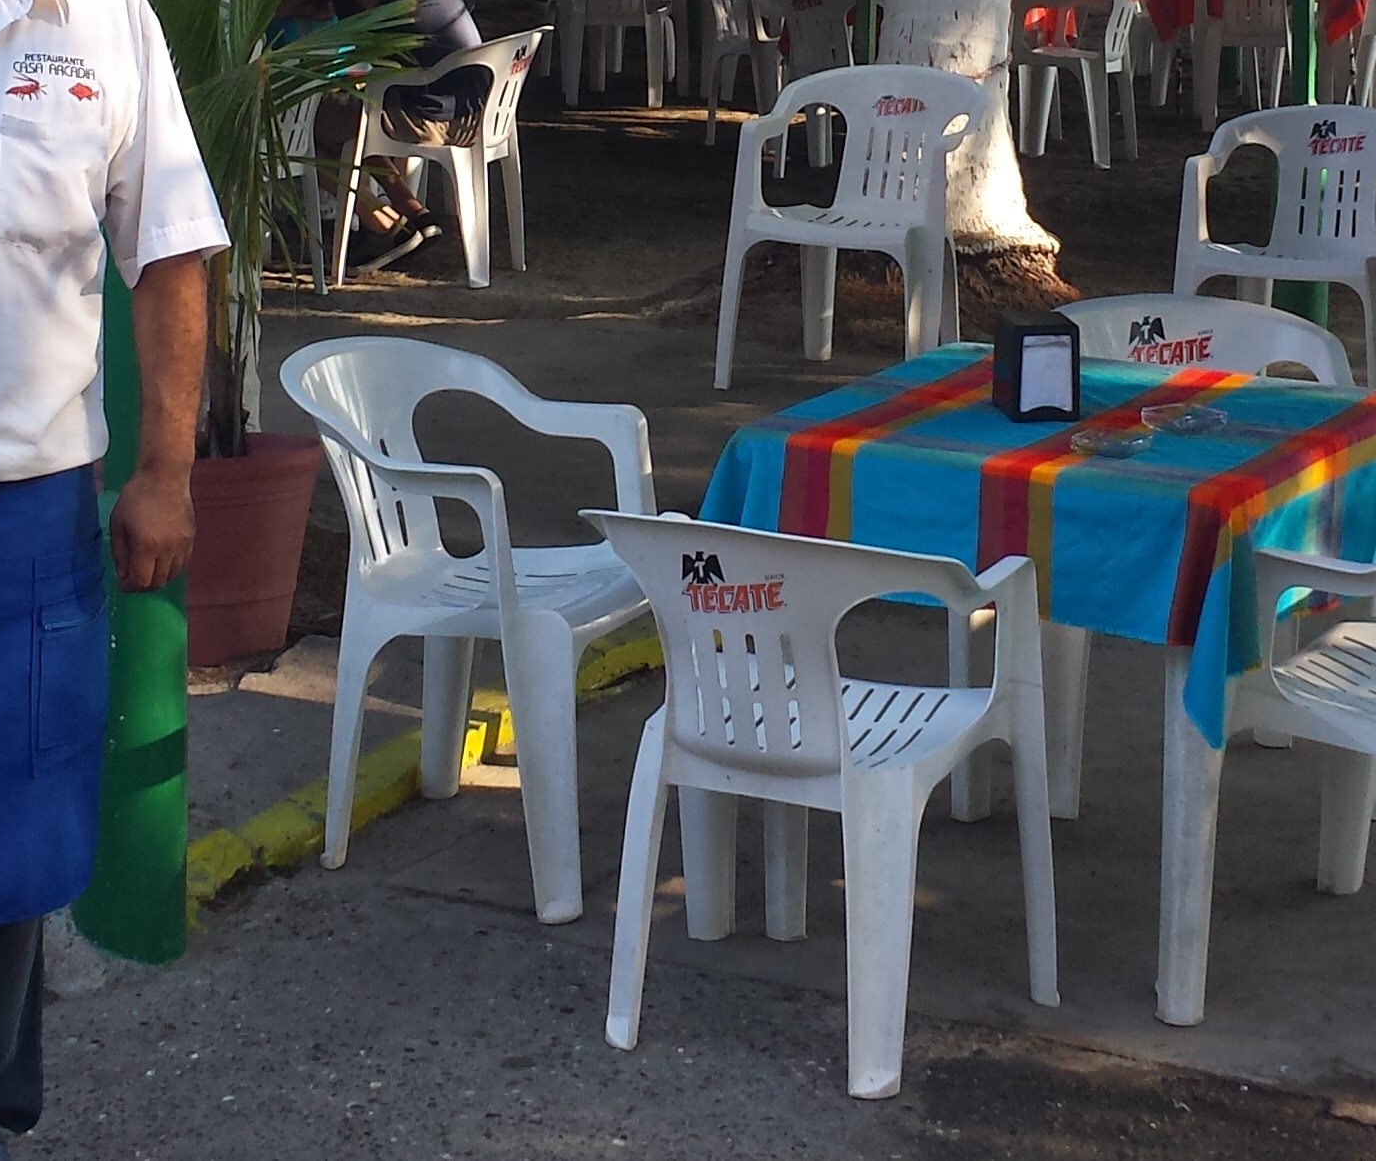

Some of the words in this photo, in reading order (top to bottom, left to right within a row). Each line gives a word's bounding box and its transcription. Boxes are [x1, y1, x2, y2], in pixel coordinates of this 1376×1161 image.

[25, 53, 84, 66] RESTAURANTE
[13, 61, 43, 74] CASA
[49, 64, 95, 80] ARCADIA
[1310, 135, 1366, 156] TECATE
[1130, 335, 1214, 366] TECATE
[683, 581, 784, 613] TECATE
